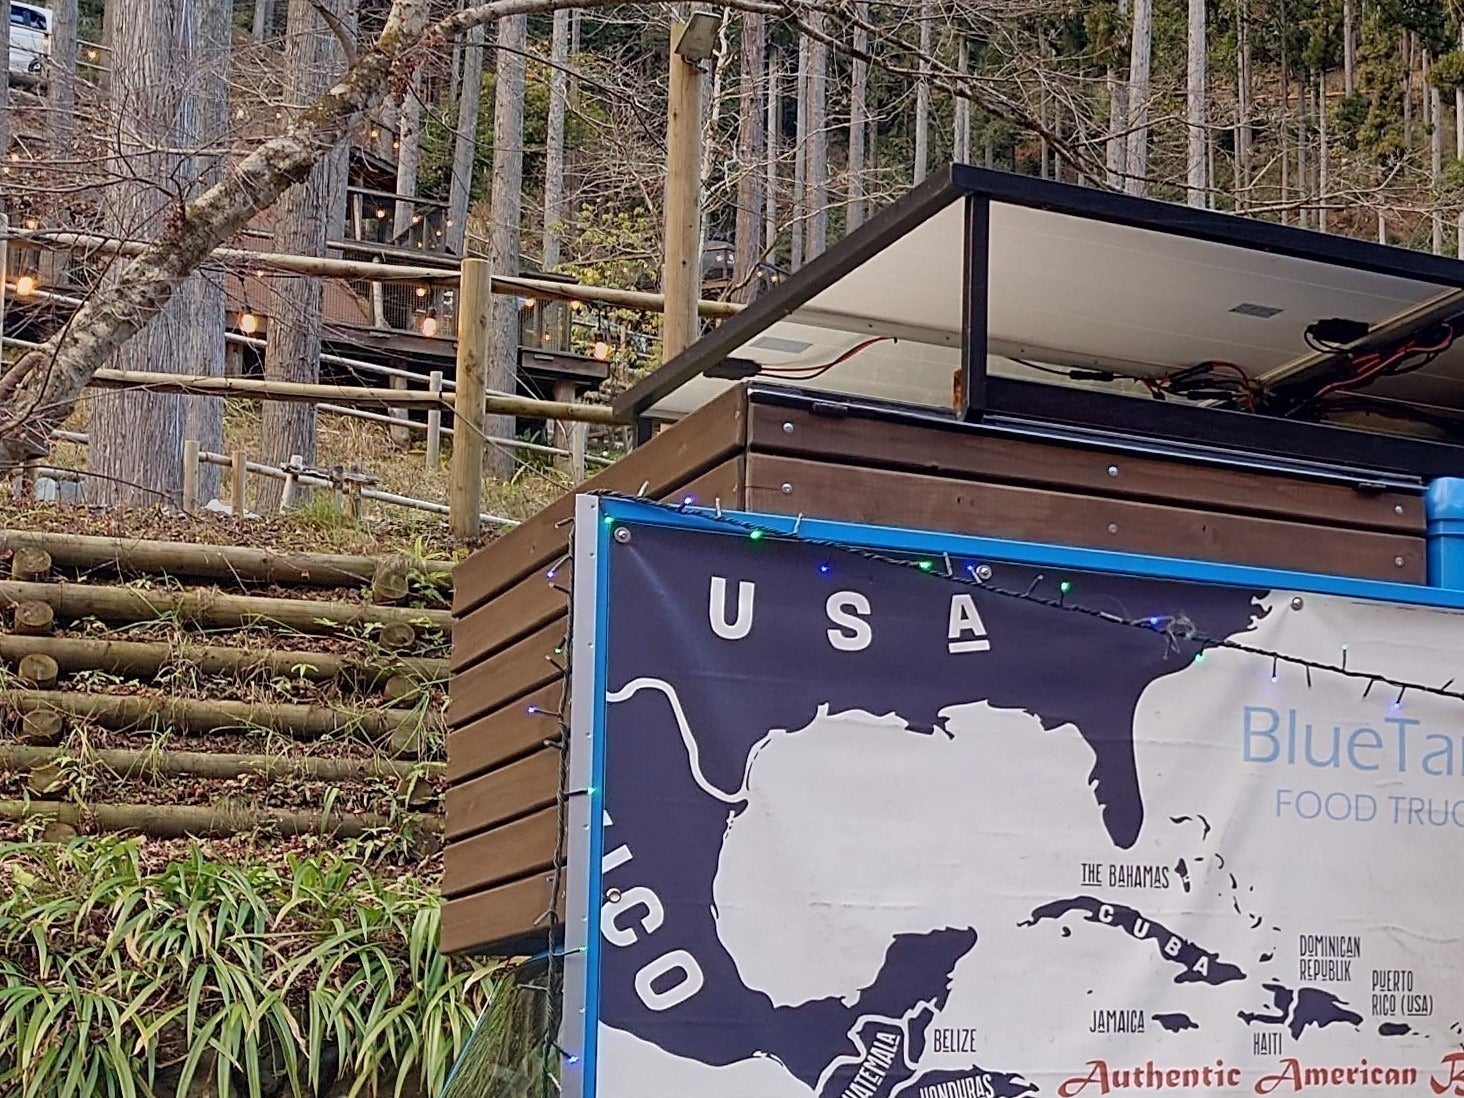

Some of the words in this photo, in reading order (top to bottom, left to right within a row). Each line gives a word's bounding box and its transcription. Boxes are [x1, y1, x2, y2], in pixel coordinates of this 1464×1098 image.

[708, 576, 990, 653] USA
[1276, 789, 1378, 822] FOOD
[1081, 863, 1103, 886] THE
[1109, 865, 1170, 889] BAHAMAS
[600, 809, 704, 1011] ICO
[1098, 904, 1209, 977] CUBA
[1299, 934, 1361, 958] DOMINICAN
[1299, 959, 1352, 981] REPUBLIK
[1372, 970, 1414, 992] PUERTO
[1372, 994, 1397, 1016] RICO
[1401, 994, 1433, 1017] (USA)
[1090, 1010, 1145, 1033] JAMAICA
[933, 1029, 977, 1053] BELIZE
[1253, 1032, 1283, 1055] HAITI
[1057, 1058, 1242, 1098] Authentic
[1254, 1058, 1417, 1095] American
